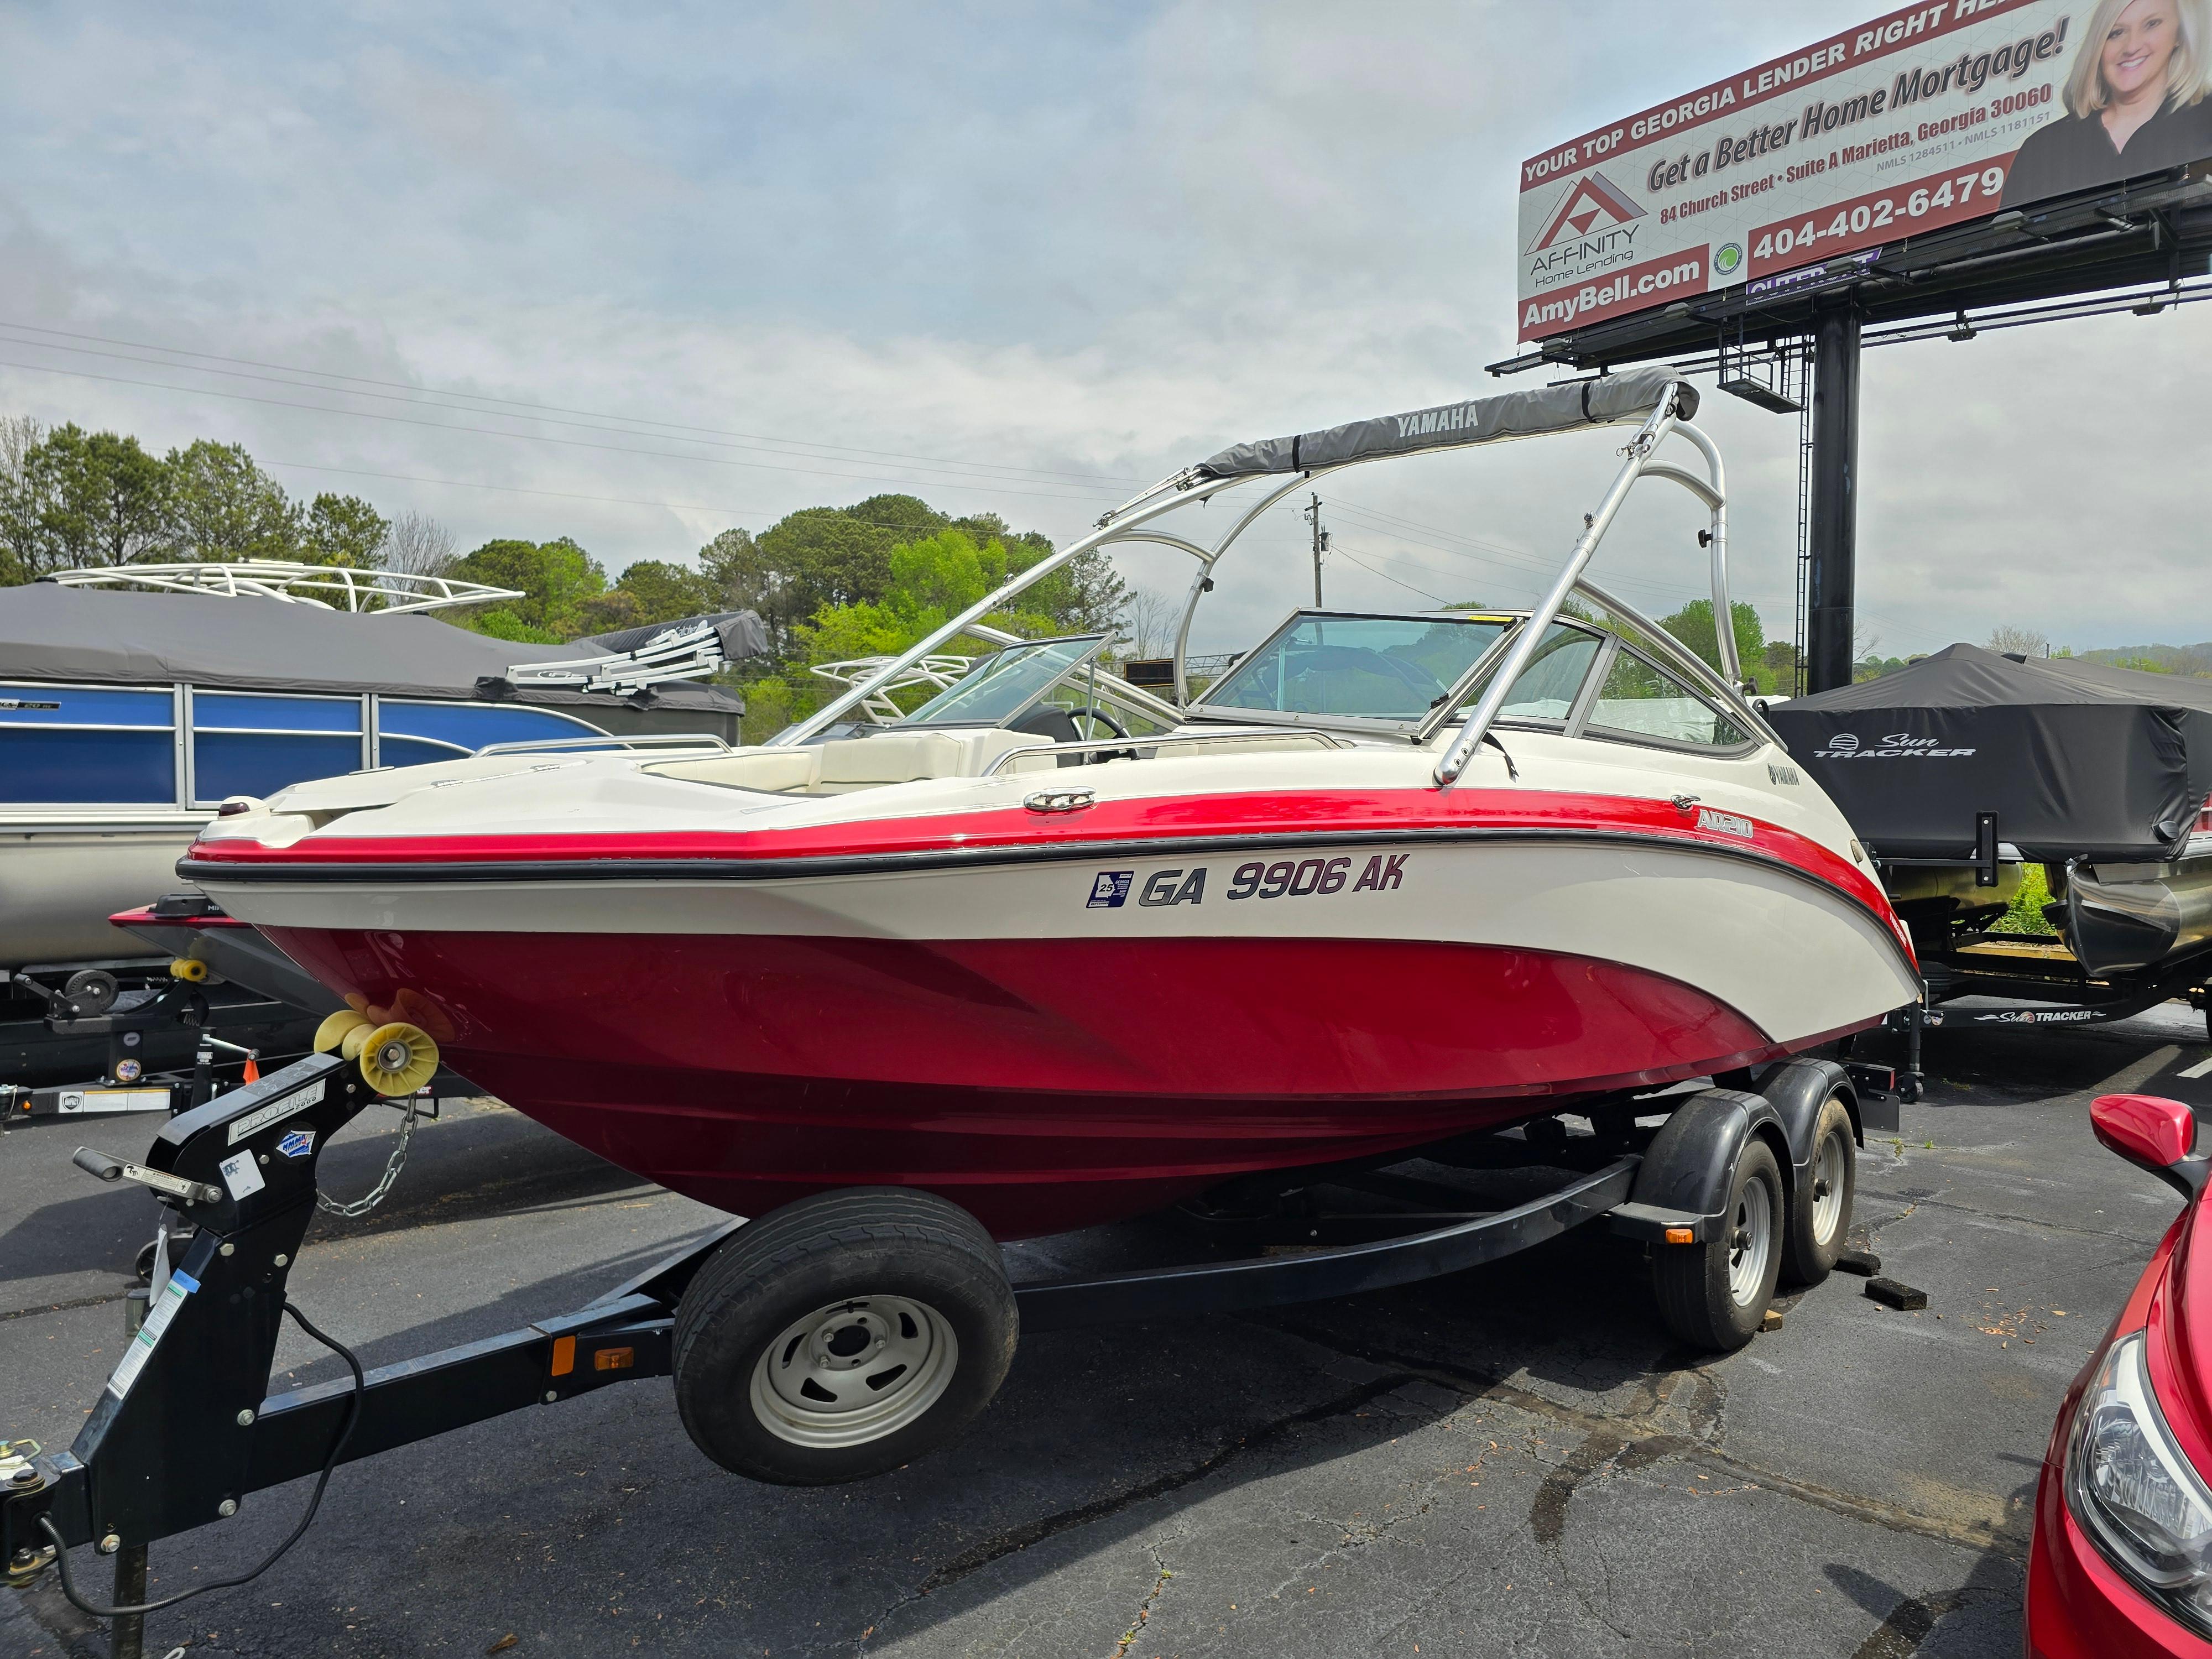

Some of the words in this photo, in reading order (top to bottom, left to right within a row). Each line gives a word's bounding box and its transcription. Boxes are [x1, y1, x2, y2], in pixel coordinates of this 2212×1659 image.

[1525, 148, 1577, 182] YOUR
[1583, 129, 1624, 159] TOP
[1631, 86, 1736, 140] GEORGIA
[1743, 43, 1846, 99] LENDER
[1854, 2, 1949, 56] RIGHT
[1650, 154, 1691, 191] Get
[1694, 151, 1710, 177] a
[1715, 118, 1798, 171] Better
[1800, 88, 1887, 142] Home
[1891, 15, 2071, 110] Mortgage!
[1660, 205, 1677, 225] 84
[1679, 190, 1728, 218] Church
[1731, 173, 1774, 202] Street
[1786, 157, 1825, 184] Suite
[1828, 152, 1839, 170] A
[1842, 131, 1914, 165] Marietta,
[1917, 106, 1986, 142] Georgia
[1990, 83, 2052, 118] 30060
[1876, 154, 1907, 173] NMLS
[1909, 141, 1955, 162] 1284511
[1964, 127, 1997, 145] NMLS
[2001, 112, 2051, 134] 1181151
[1754, 166, 2005, 259] 404-402-6479
[1530, 224, 1639, 276] AFFINITY
[1536, 269, 1574, 288] Home
[1577, 250, 1634, 274] Lending
[1522, 260, 1699, 328] AmyBell.com
[1397, 404, 1479, 437] YAMAHA
[1813, 749, 1976, 758] TRACKER
[1874, 733, 1939, 747] Sun
[1772, 765, 1800, 786] YAMAHA
[1697, 808, 1754, 838] AR210
[1098, 884, 1114, 893] 25
[1138, 868, 1207, 907] GA
[1227, 857, 1352, 900] 9906
[1352, 853, 1411, 893] AK
[1996, 1011, 2031, 1022] Sun
[2036, 1011, 2091, 1022] TRACKER
[238, 1086, 317, 1134] PROFILE
[295, 1097, 317, 1110] 2000
